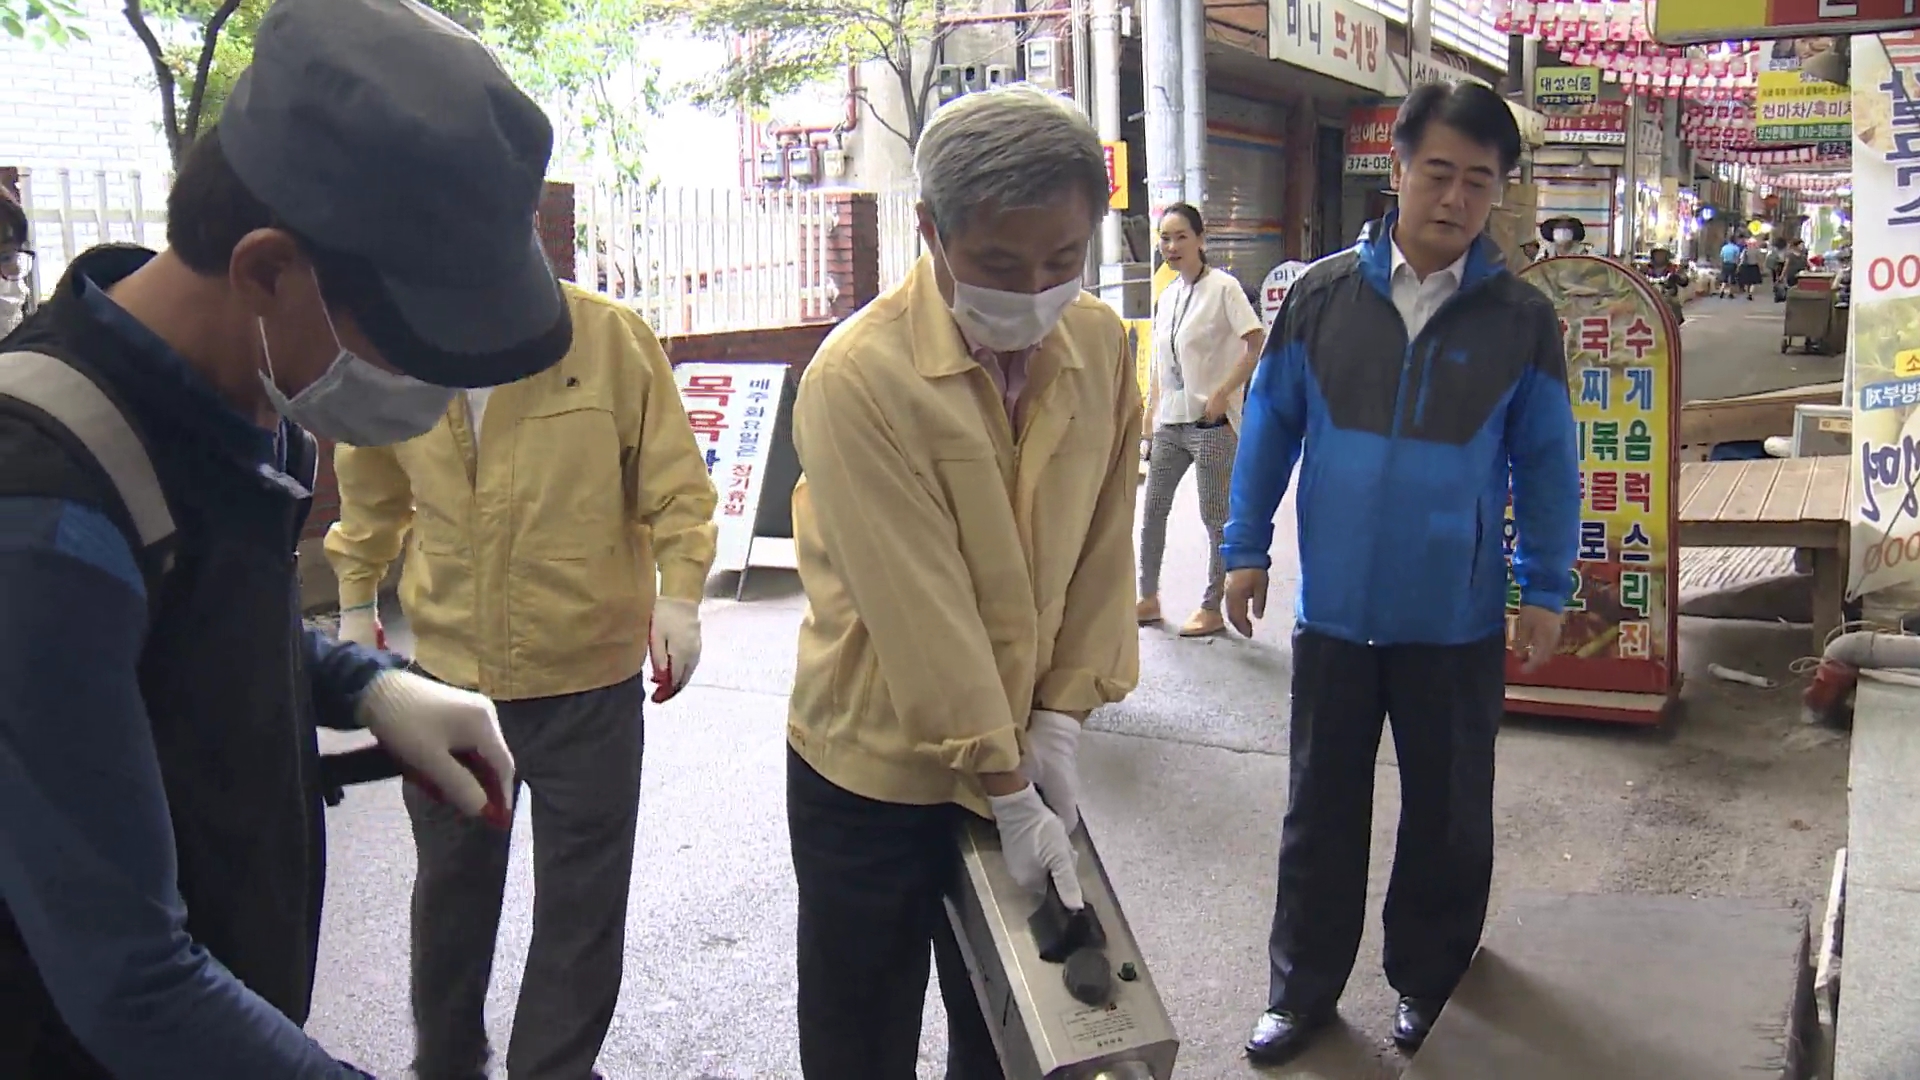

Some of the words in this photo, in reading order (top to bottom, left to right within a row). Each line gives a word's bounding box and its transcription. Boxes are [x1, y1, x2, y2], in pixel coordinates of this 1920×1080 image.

[1287, 0, 1322, 54] 미니
[1540, 76, 1592, 92] 대성식품
[1562, 317, 1654, 359] 국수
[1578, 420, 1653, 462] 볶음
[1580, 471, 1652, 514] 물럭
